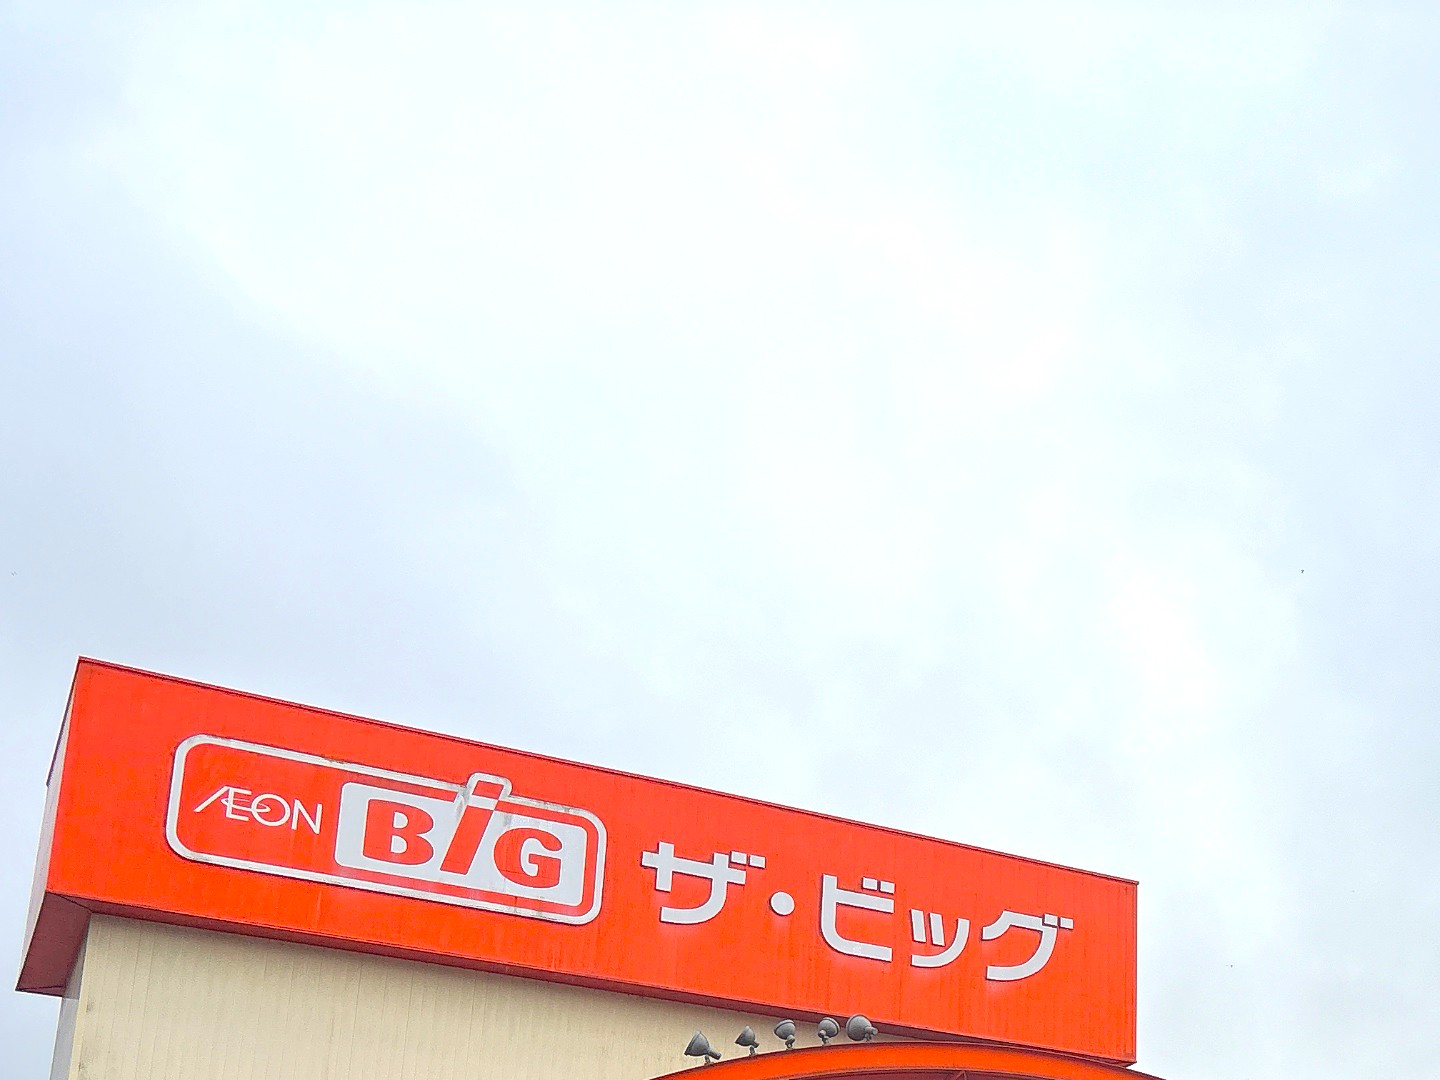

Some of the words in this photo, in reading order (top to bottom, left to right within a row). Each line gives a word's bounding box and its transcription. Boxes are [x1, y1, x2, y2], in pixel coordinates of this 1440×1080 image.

[641, 841, 1074, 981] ザ・ビッグ
